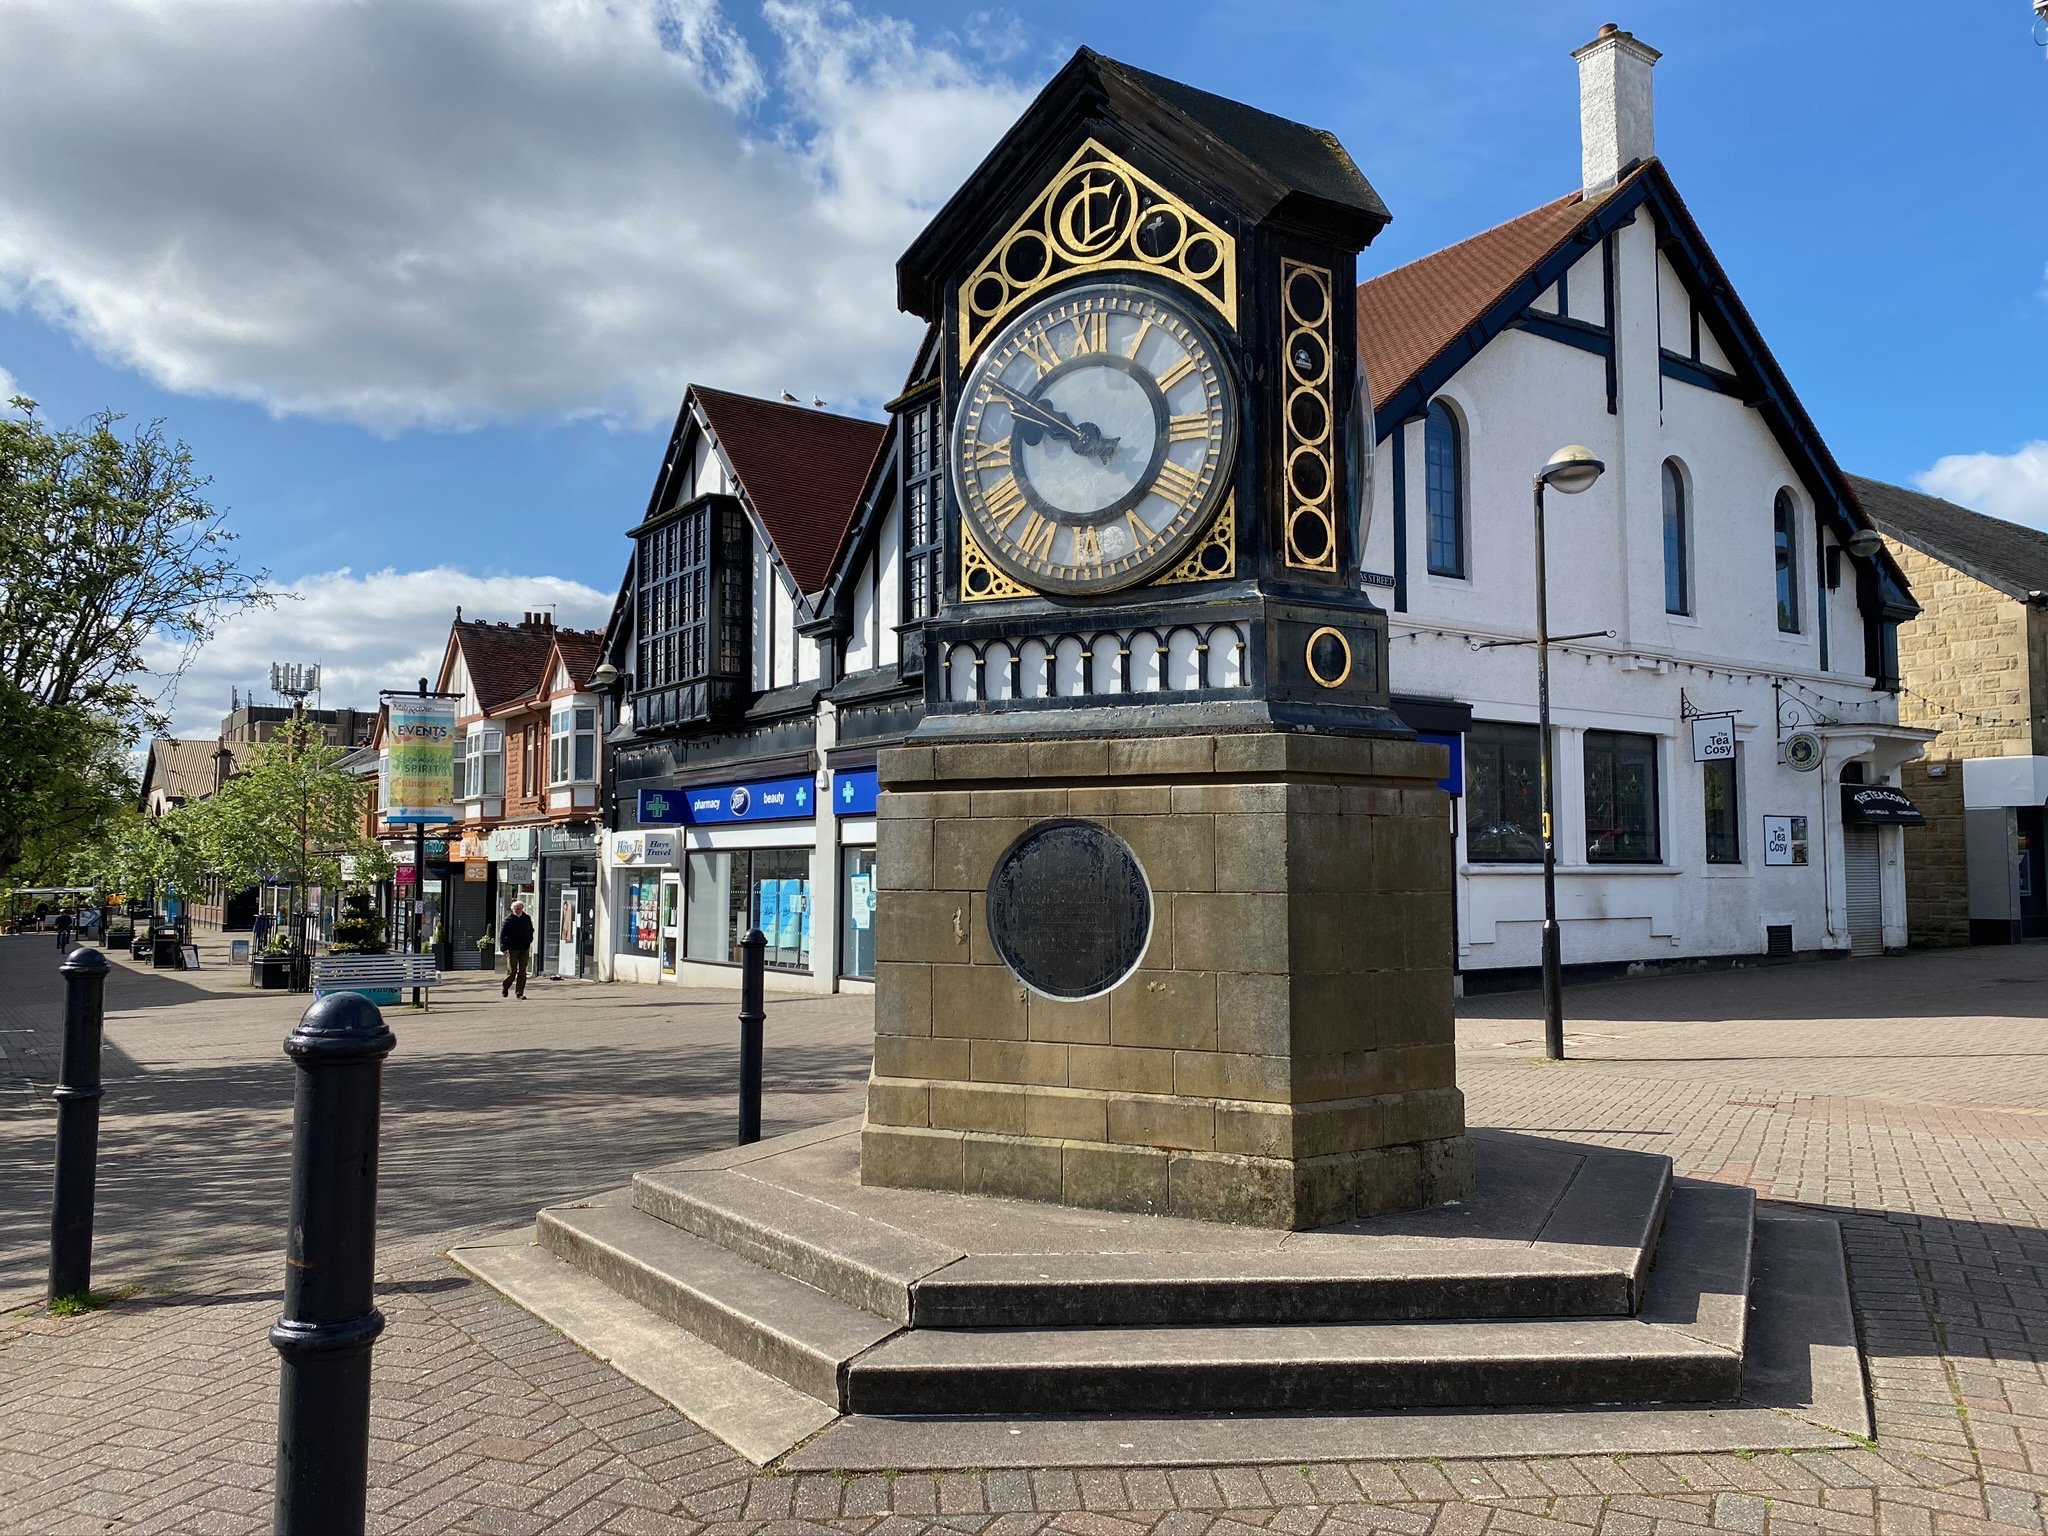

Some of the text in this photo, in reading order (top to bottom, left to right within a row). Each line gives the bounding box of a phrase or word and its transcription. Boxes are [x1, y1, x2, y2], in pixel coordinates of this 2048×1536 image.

[1368, 575, 1393, 586] STREET
[397, 725, 447, 737] EVENTS
[1709, 736, 1729, 746] Tea
[1704, 745, 1732, 756] Cosy
[405, 764, 439, 773] SPIRIT
[763, 791, 785, 805] beauty
[1854, 790, 1871, 804] THE
[1866, 790, 1886, 800] TEA
[694, 798, 720, 812] pharmacy
[1772, 830, 1786, 841] Tea
[649, 840, 670, 850] Hays
[1769, 840, 1788, 855] Cosy
